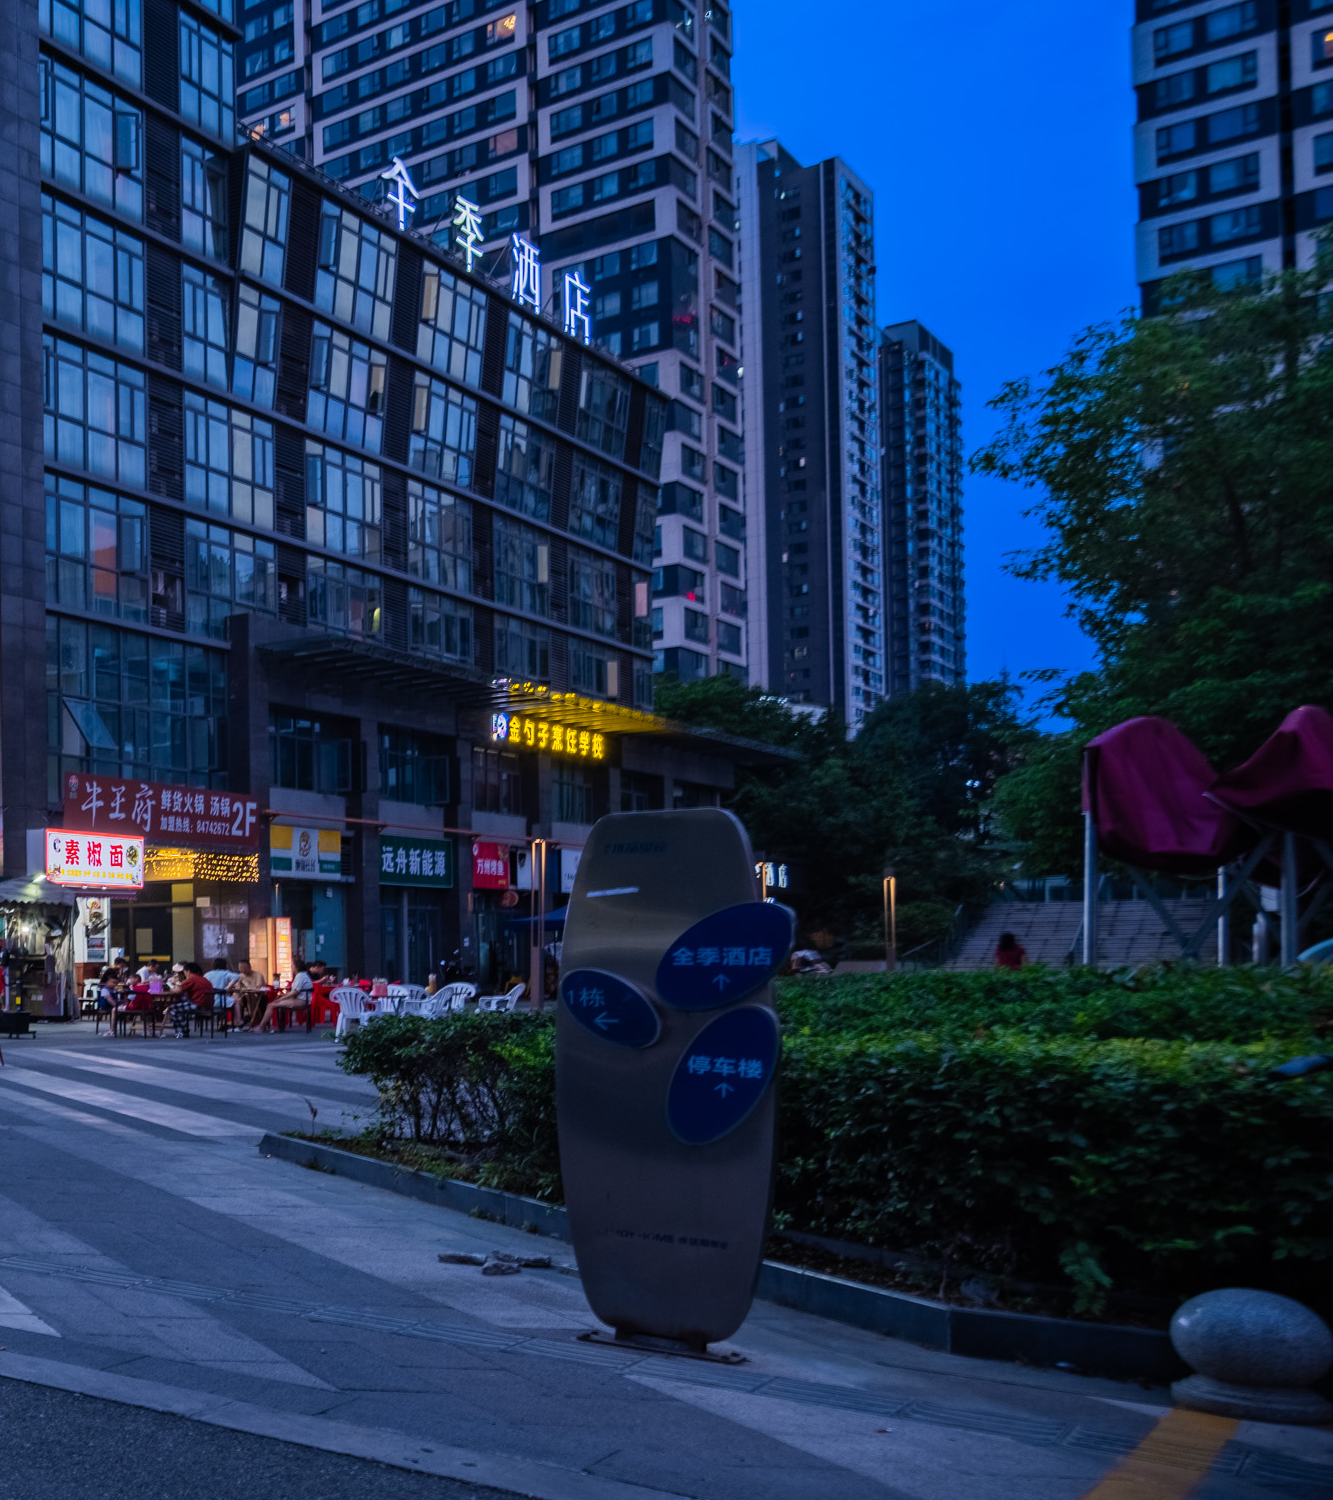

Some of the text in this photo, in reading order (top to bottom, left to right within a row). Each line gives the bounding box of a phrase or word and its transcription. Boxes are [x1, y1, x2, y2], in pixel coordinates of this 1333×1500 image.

[382, 156, 591, 345] 全季酒店
[509, 716, 604, 759] 金勺子烹饪学校
[81, 781, 156, 832] 牛王府
[232, 801, 257, 837] 2F
[65, 839, 123, 868] 素椒面
[382, 845, 446, 877] 远舟新能源
[672, 946, 773, 967] 全季酒店
[567, 987, 605, 1008] 1栋
[687, 1054, 763, 1079] 停车楼
